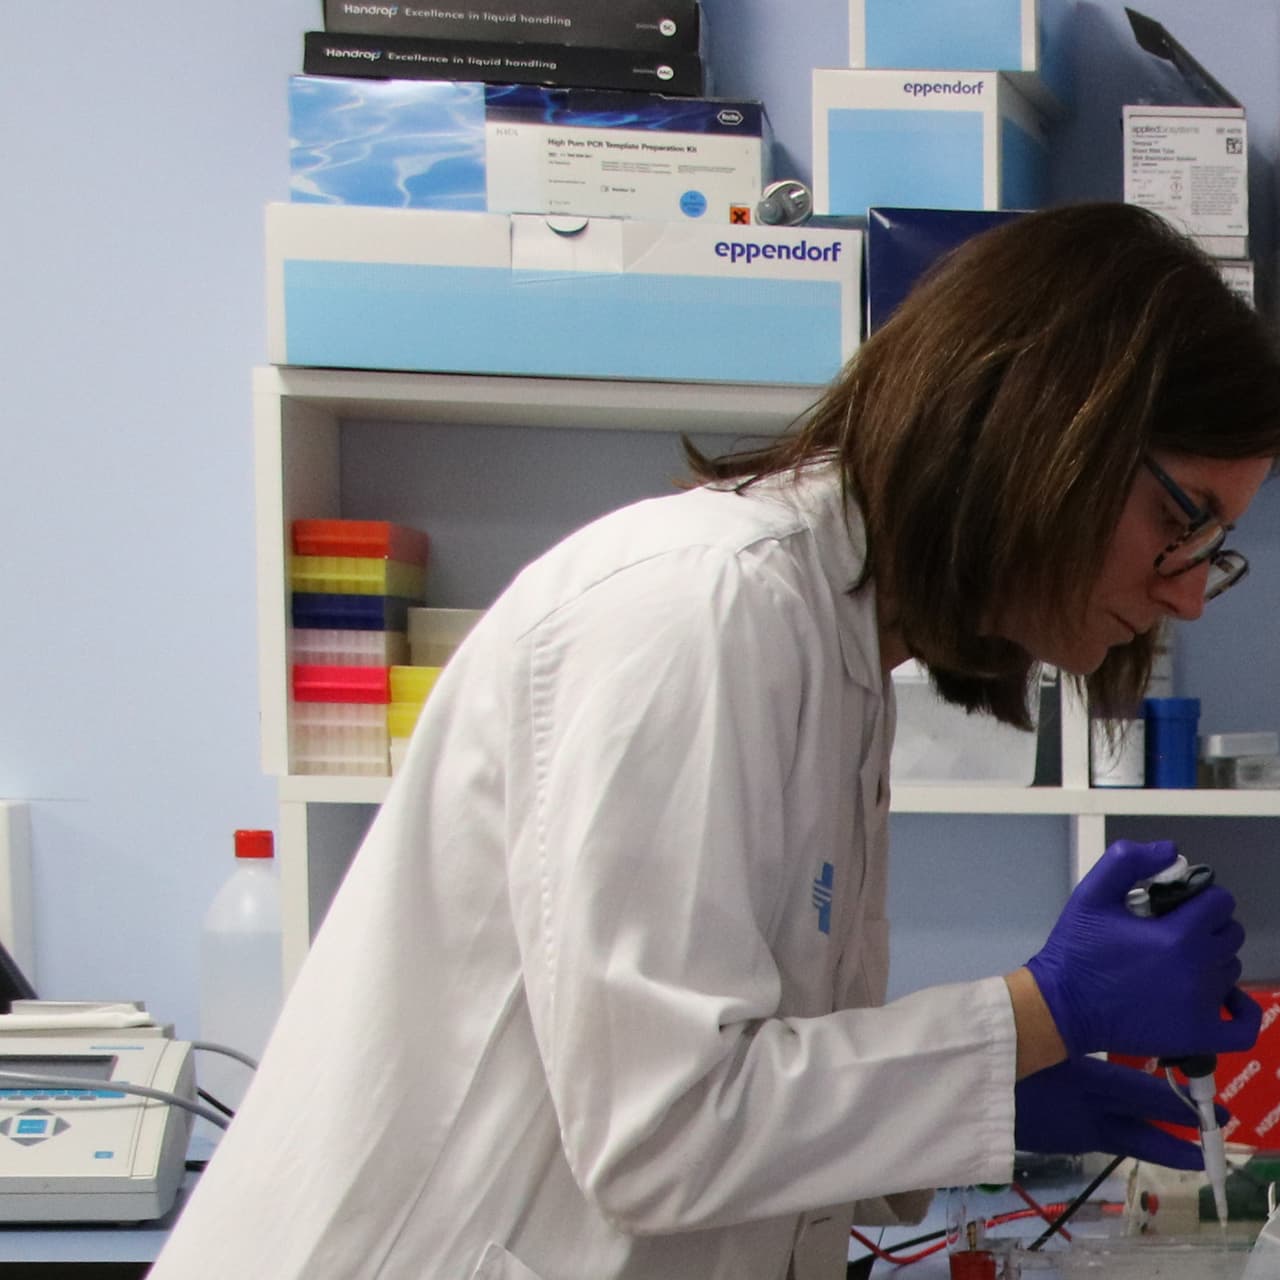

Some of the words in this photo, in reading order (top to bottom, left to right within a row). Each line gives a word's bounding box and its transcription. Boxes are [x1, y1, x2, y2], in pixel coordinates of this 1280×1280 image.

[344, 4, 397, 18] Handrop
[405, 8, 464, 19] Excellence
[468, 12, 479, 20] in
[483, 12, 516, 24] liquid
[520, 14, 571, 27] handling
[325, 48, 382, 61] Handrop
[388, 52, 448, 64] Excellence
[452, 56, 464, 65] in
[467, 56, 501, 68] liquid
[504, 59, 557, 70] handling
[903, 81, 984, 96] eppendorf
[548, 138, 565, 149] High
[587, 140, 603, 149] PCR
[606, 141, 640, 152] Template
[641, 143, 685, 154] Preparation
[715, 240, 842, 263] eppendorf
[1219, 1059, 1262, 1103] QIAGEN
